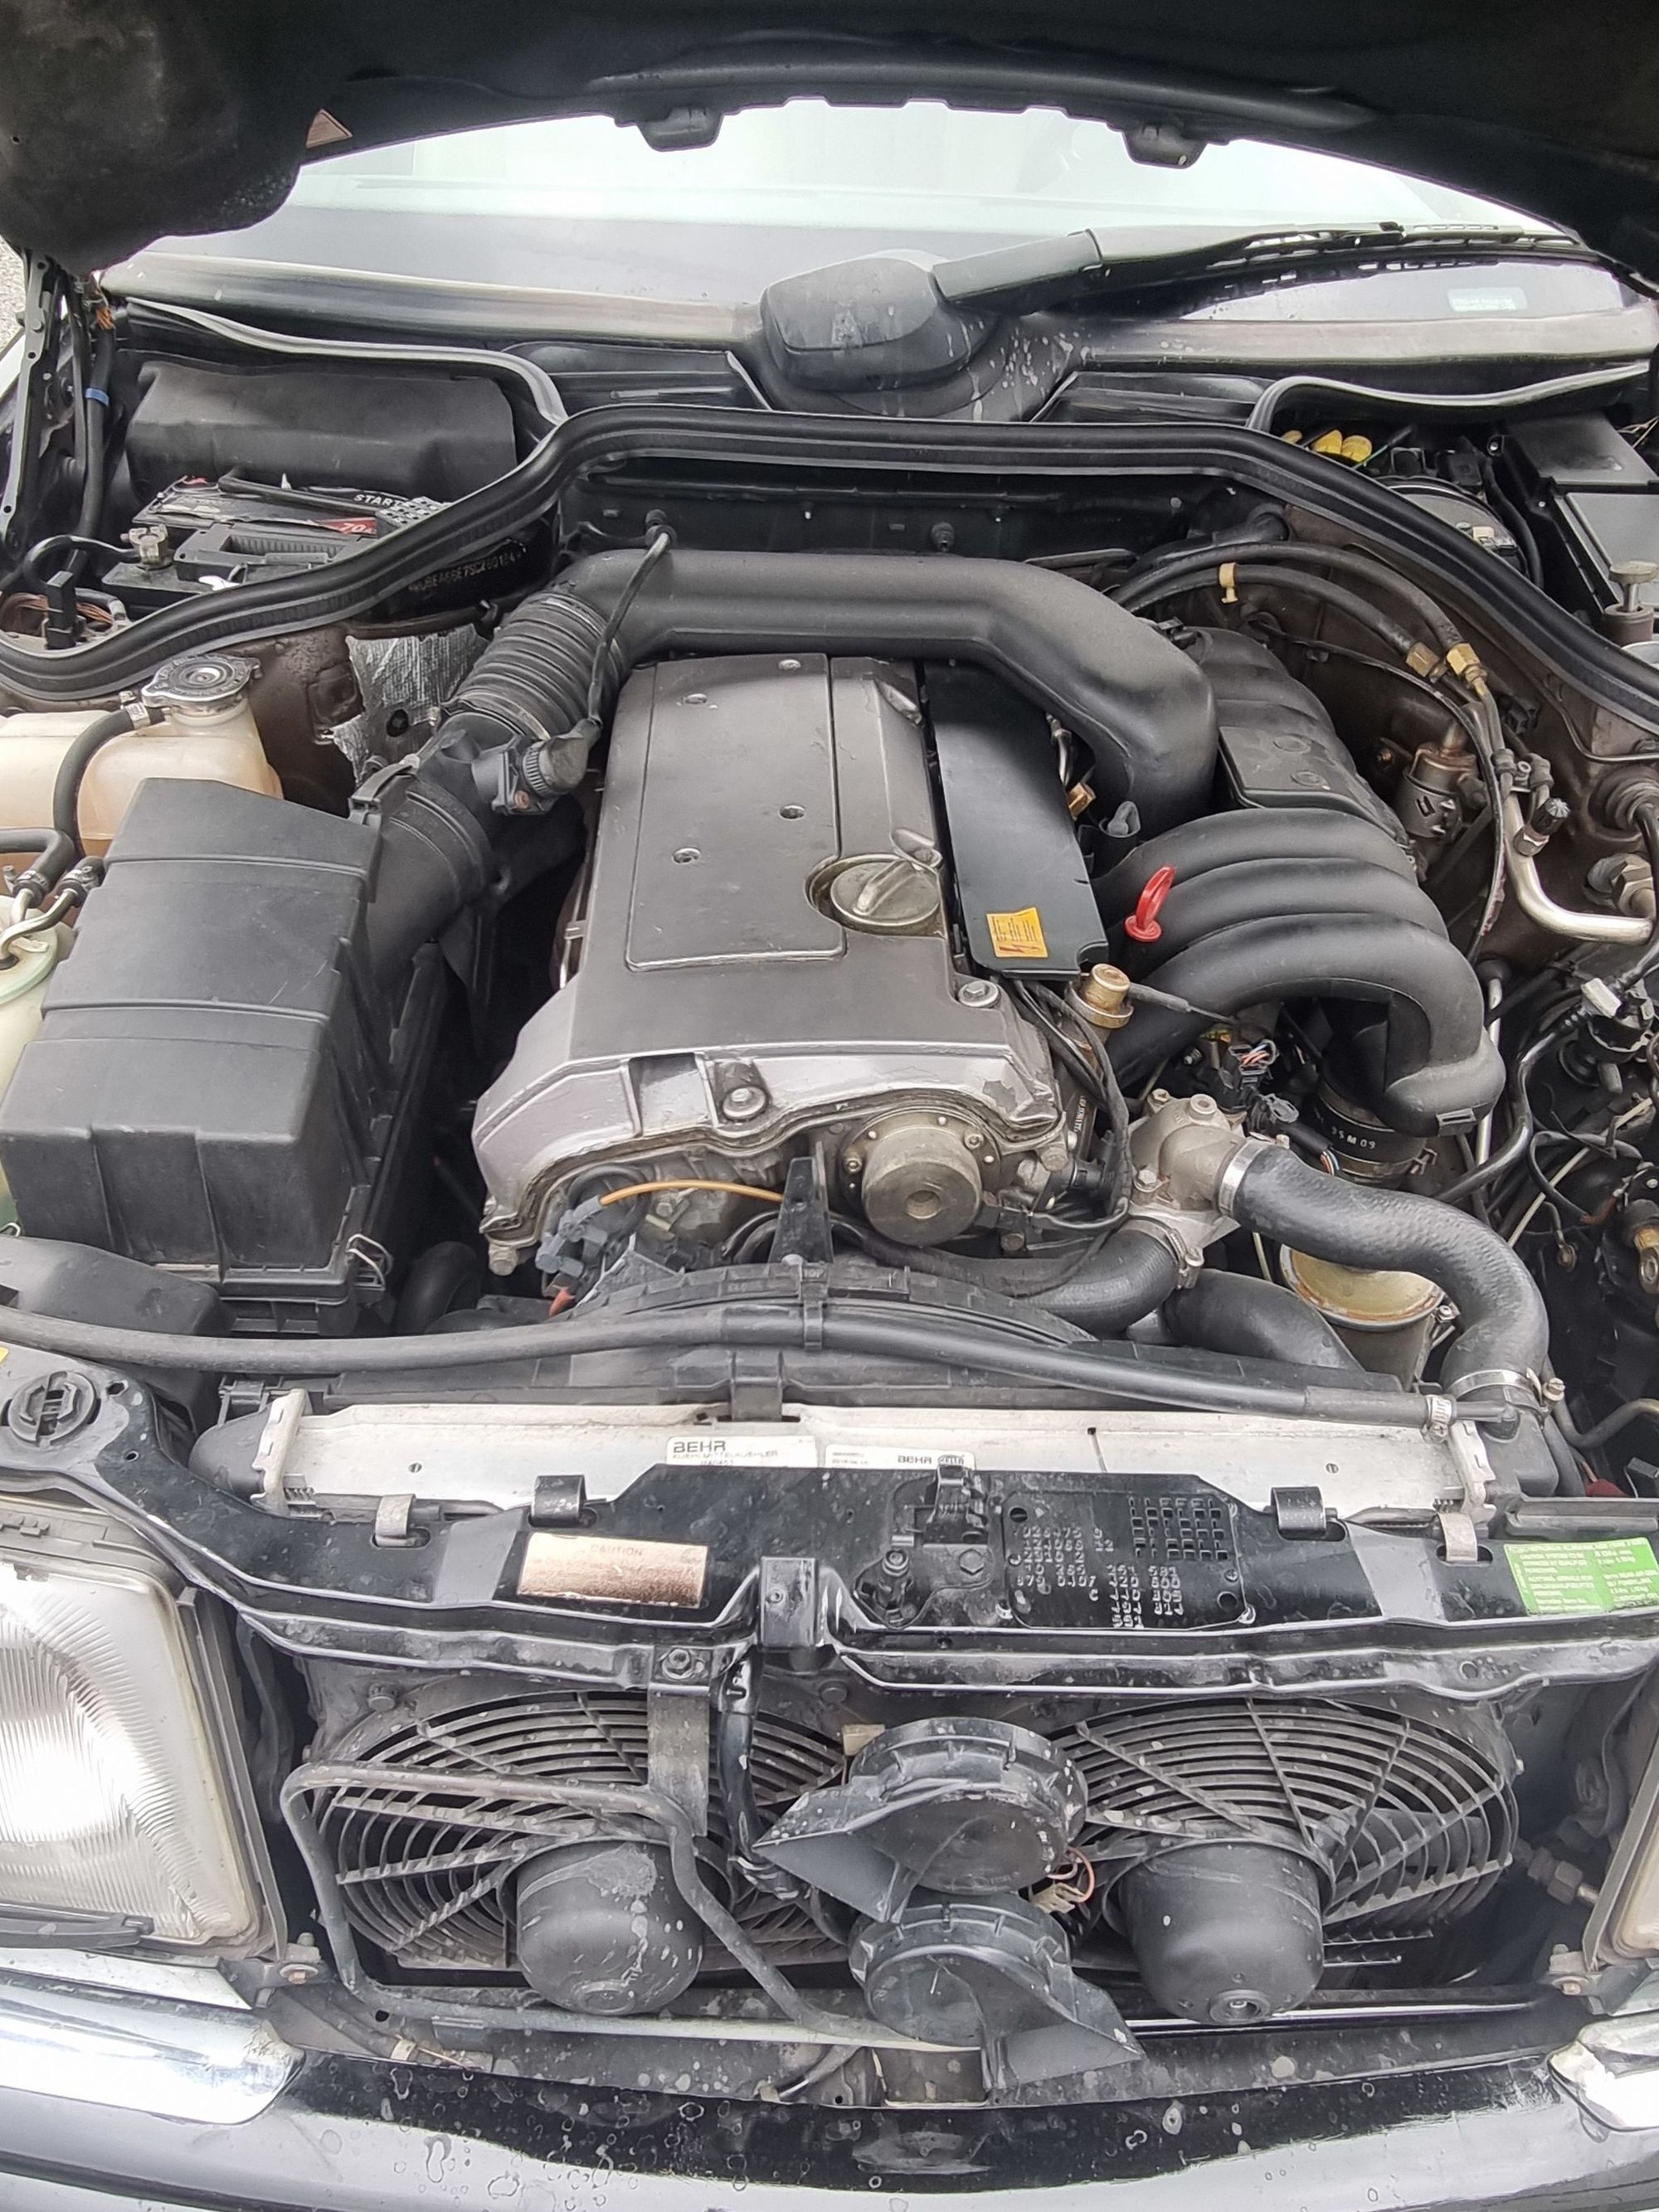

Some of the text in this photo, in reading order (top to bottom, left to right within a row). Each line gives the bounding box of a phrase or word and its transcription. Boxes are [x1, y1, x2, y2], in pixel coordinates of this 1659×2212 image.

[674, 1440, 726, 1453] BEHR
[898, 1455, 932, 1465] BEHR
[591, 1544, 643, 1558] CAUTION
